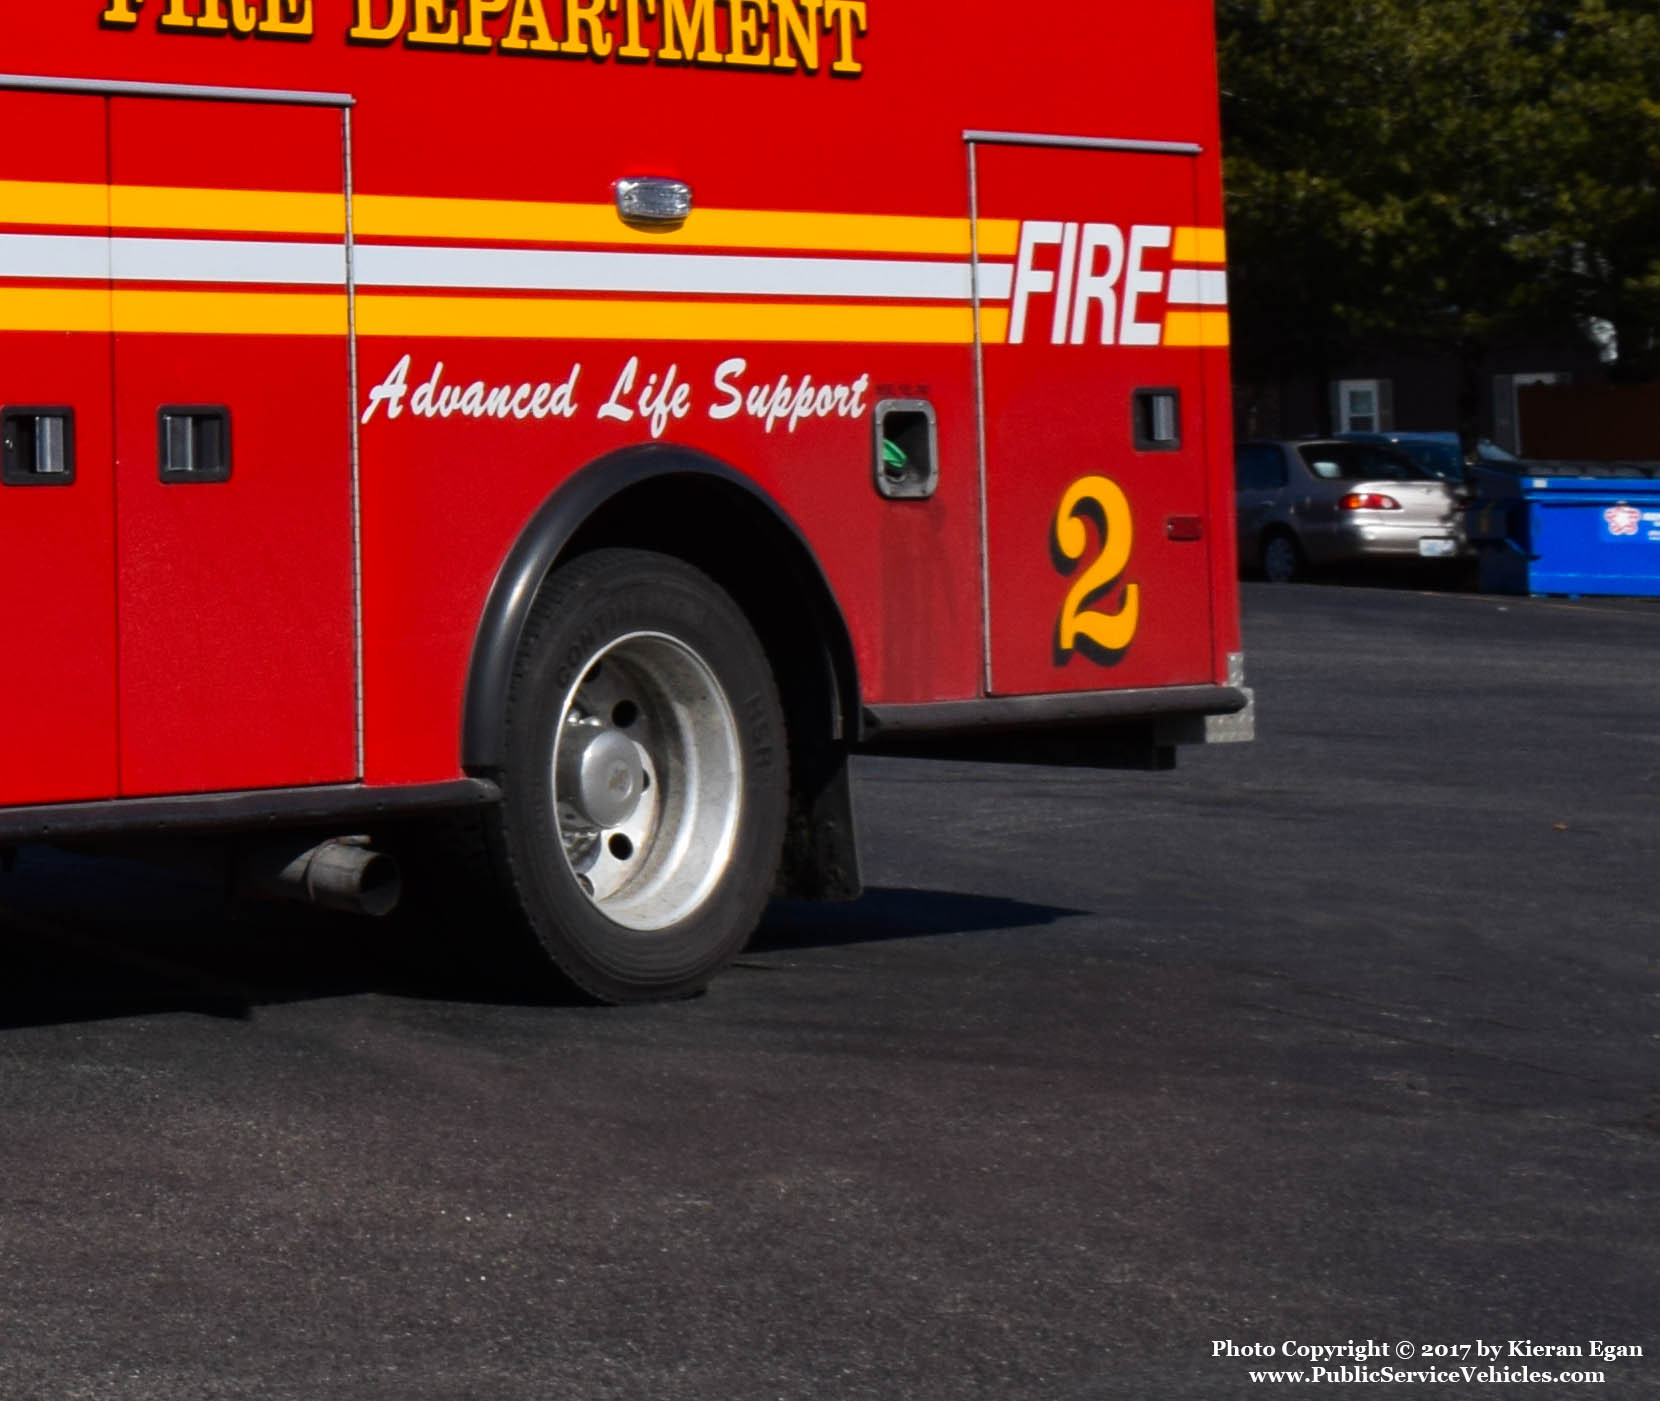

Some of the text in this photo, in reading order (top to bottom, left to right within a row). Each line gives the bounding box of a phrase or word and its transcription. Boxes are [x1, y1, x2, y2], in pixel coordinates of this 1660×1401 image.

[1008, 220, 1172, 347] FIRE
[361, 354, 870, 439] Advanced Life Support
[1052, 475, 1140, 664] 2
